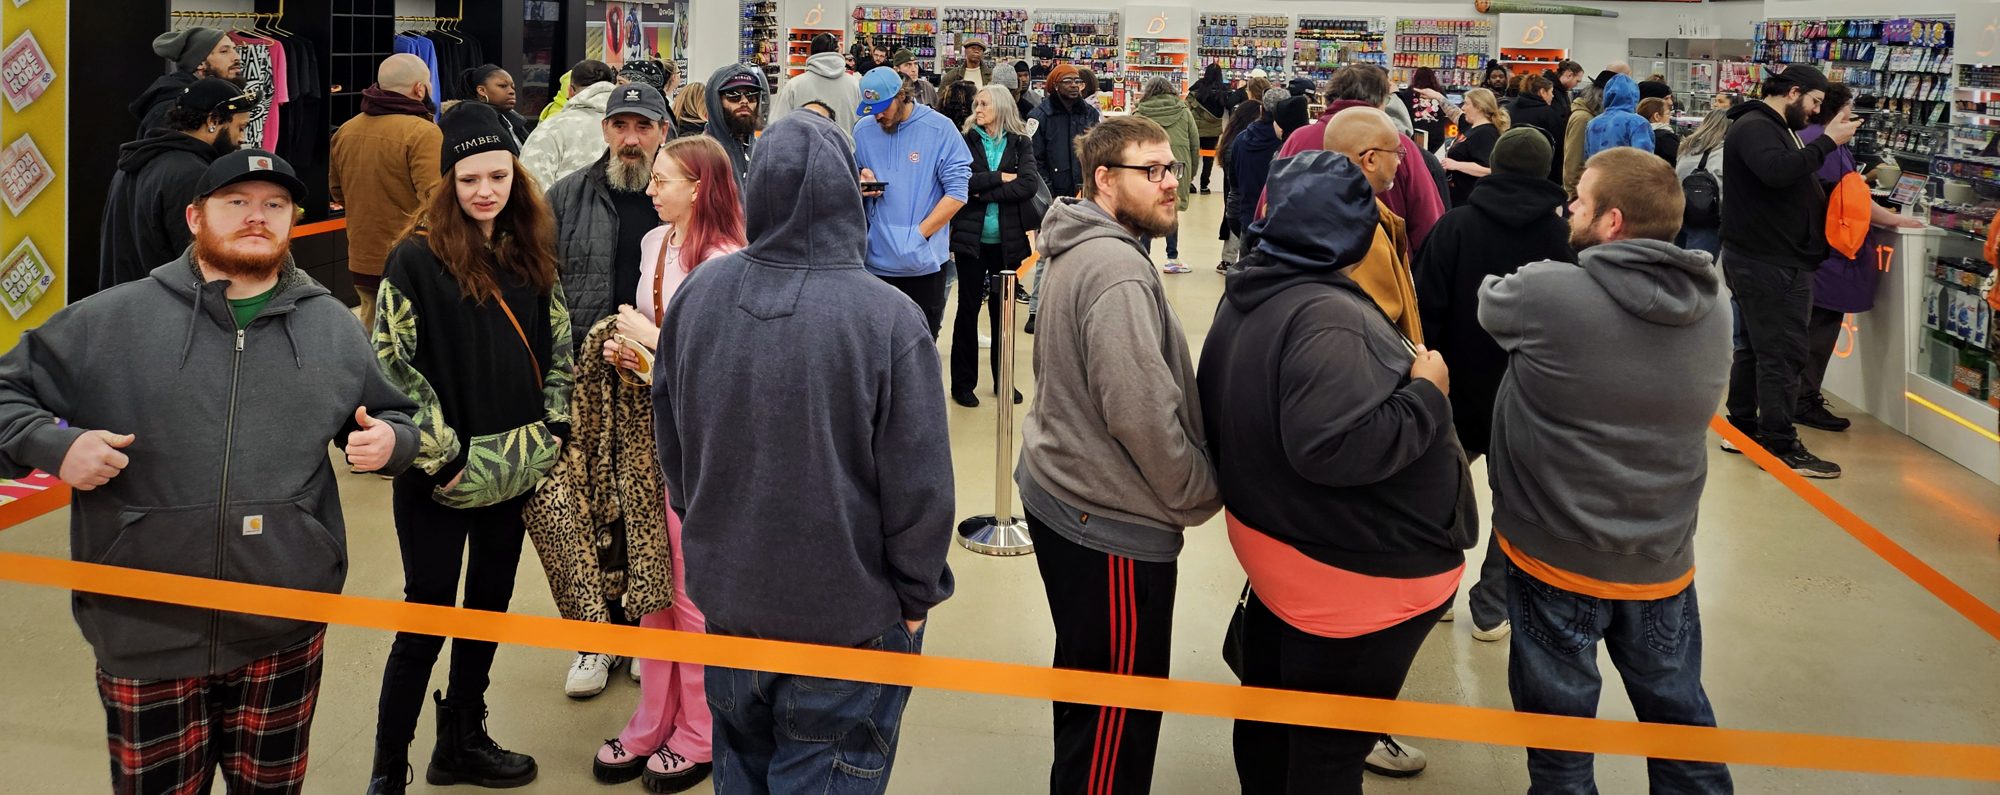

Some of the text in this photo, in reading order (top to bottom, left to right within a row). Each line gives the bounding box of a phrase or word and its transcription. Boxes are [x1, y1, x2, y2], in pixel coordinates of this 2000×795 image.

[3, 48, 36, 83] DOPE
[10, 60, 42, 94] ROPE
[453, 135, 501, 153] TIMBER
[2, 151, 35, 188] ROPE
[9, 162, 41, 198] DOPE
[2, 255, 35, 292] DOPE
[1876, 244, 1894, 272] 17
[8, 264, 41, 302] ROPE
